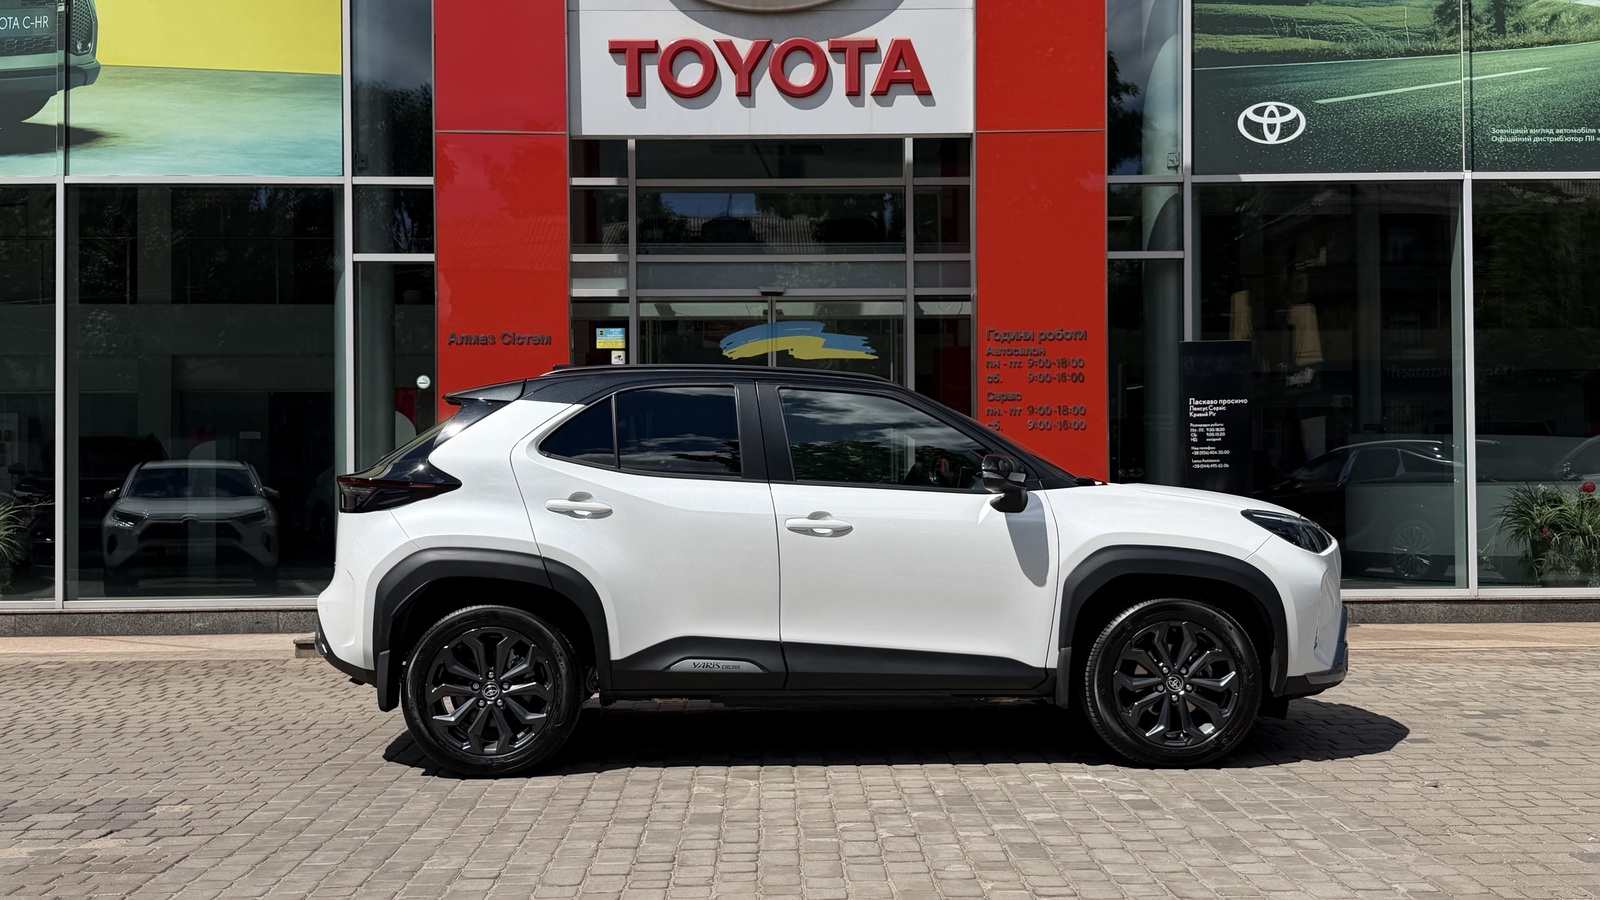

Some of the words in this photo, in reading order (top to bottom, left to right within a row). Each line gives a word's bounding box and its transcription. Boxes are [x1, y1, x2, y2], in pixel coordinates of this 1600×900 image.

[22, 15, 49, 29] C-HR
[608, 38, 933, 98] TOYOTA
[1491, 135, 1531, 143] Офіційний
[448, 331, 495, 345] Алмаз
[500, 331, 551, 345] Сістем
[986, 328, 1034, 343] Години
[1038, 328, 1087, 344] роботи
[986, 346, 1045, 356] Автосалон
[986, 373, 1002, 384] сб.
[986, 390, 1022, 404] Сервіс
